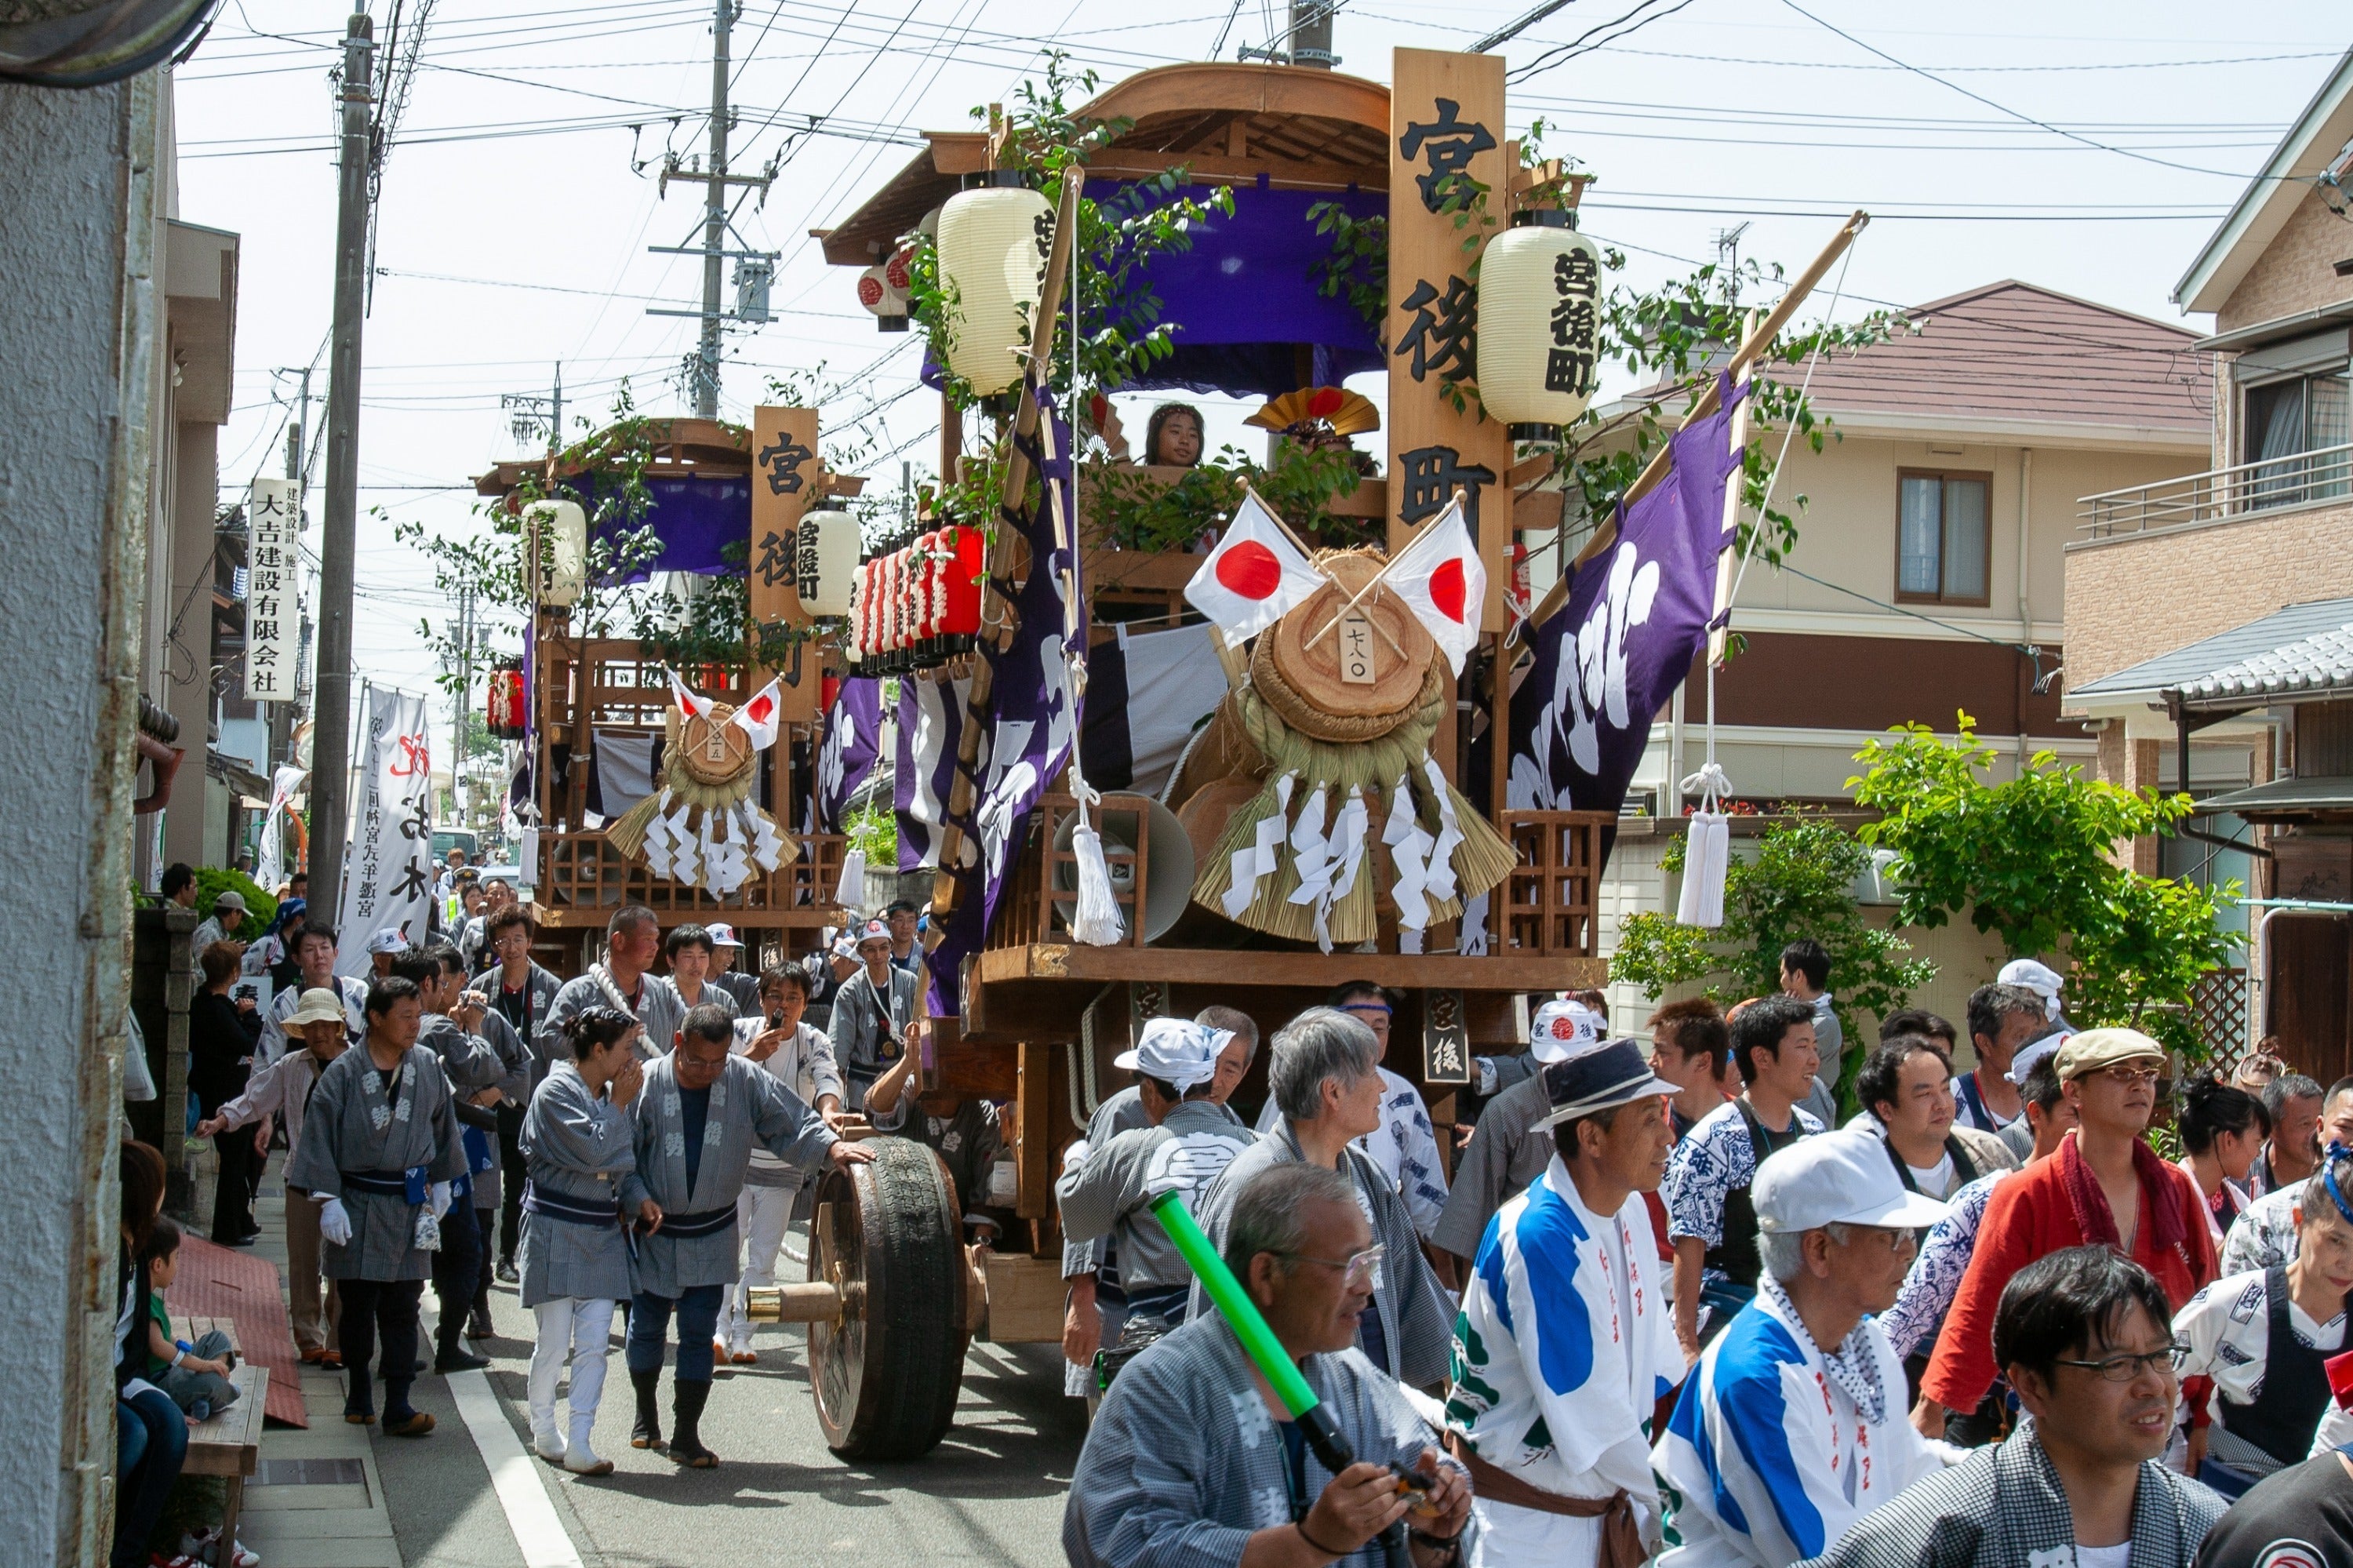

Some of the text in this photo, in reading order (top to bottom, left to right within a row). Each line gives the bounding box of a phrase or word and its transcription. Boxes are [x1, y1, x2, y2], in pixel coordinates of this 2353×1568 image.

[1394, 97, 1497, 563] 宮後町
[1544, 246, 1598, 398] 宮後町
[284, 487, 298, 581] 建築設計 施工
